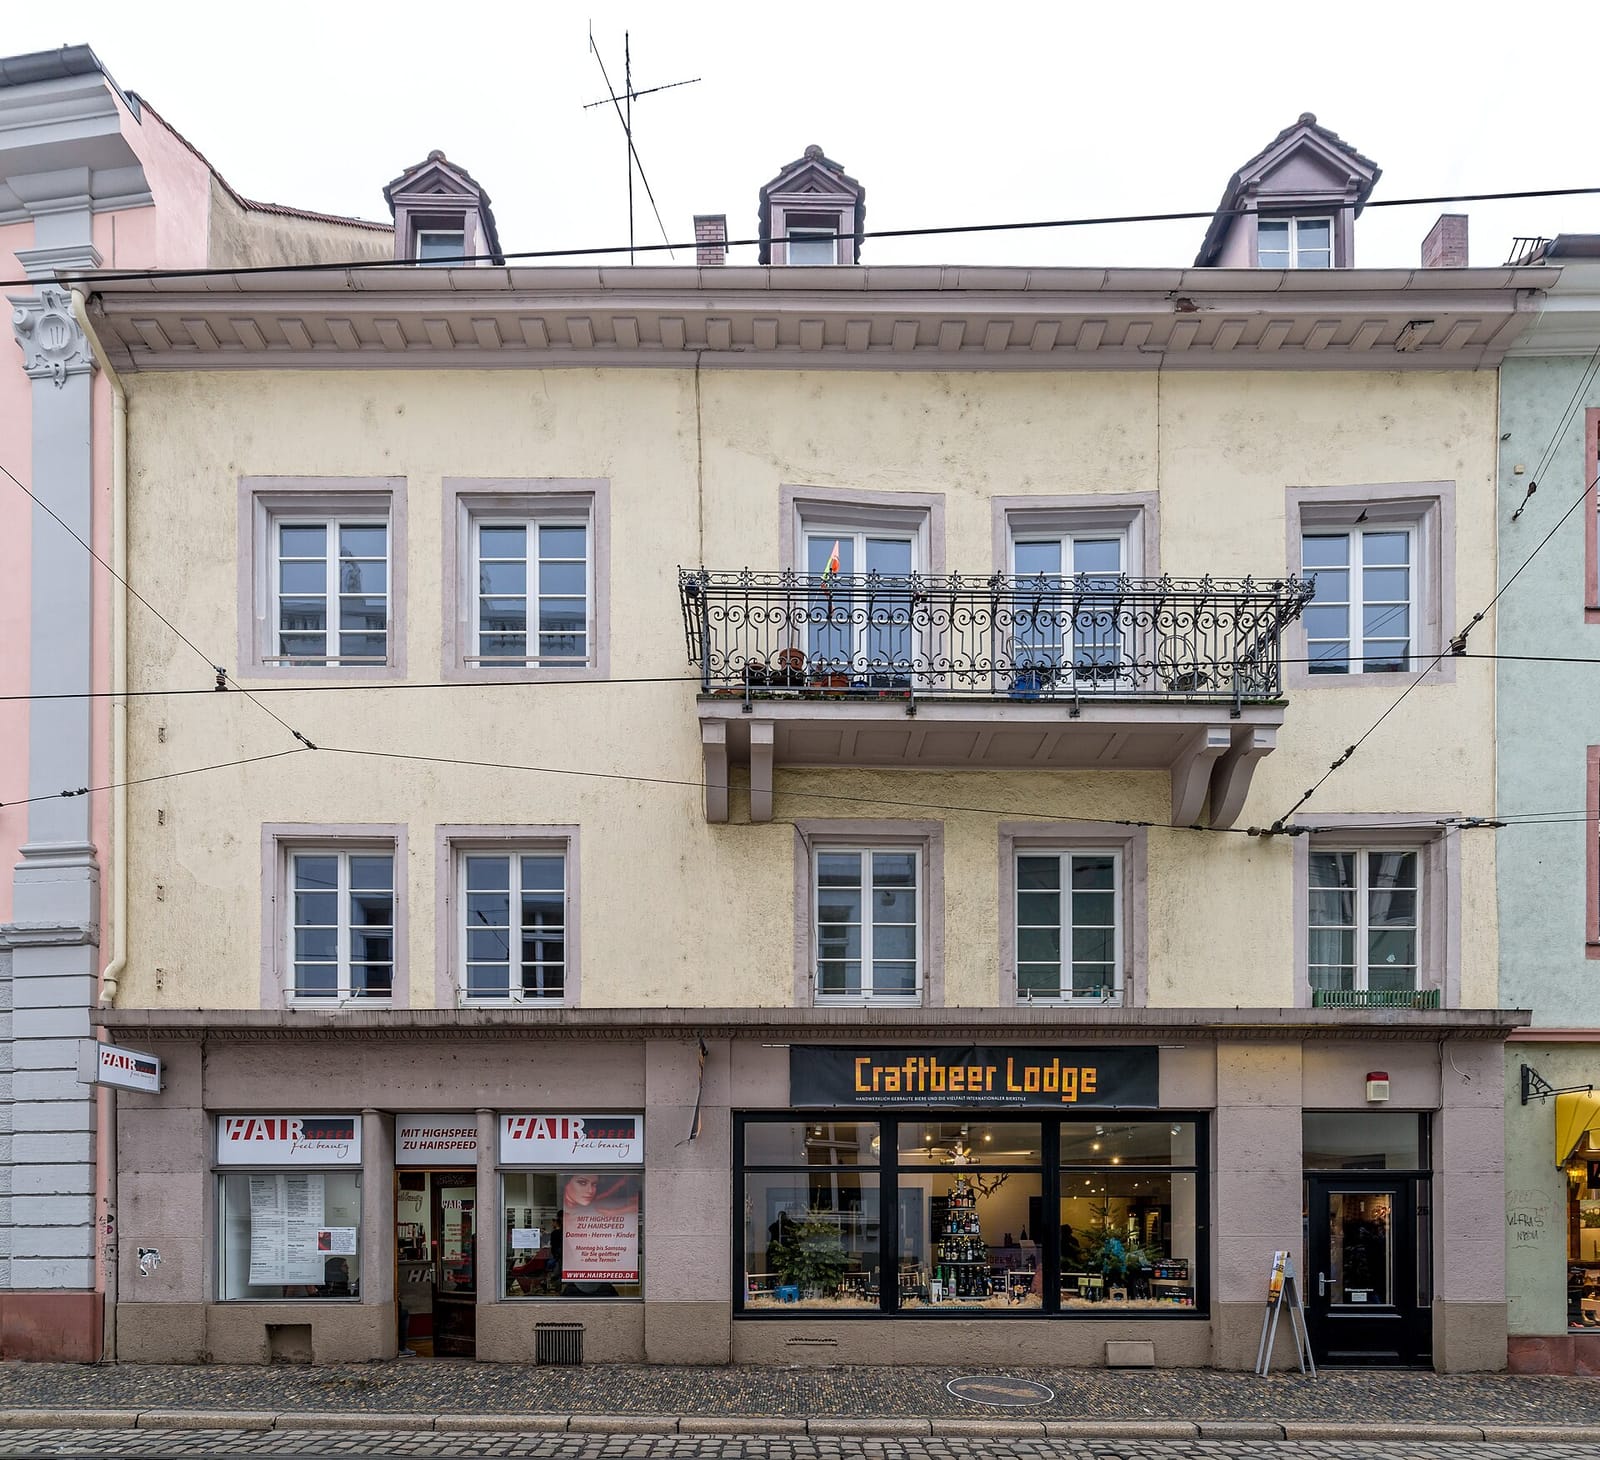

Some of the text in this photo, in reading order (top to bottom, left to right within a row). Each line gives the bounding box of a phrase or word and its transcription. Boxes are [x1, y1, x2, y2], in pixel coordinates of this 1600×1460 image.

[102, 1052, 137, 1071] HAIR
[855, 1057, 1097, 1102] Craftbeer Lodge
[226, 1119, 304, 1140] HAIR
[401, 1128, 420, 1138] MIT
[507, 1118, 585, 1139] HAIR
[316, 1141, 349, 1158] beauty
[403, 1141, 477, 1150] ZU HAIRSPEED
[597, 1140, 630, 1158] beauty
[597, 1251, 620, 1259] geöffnet
